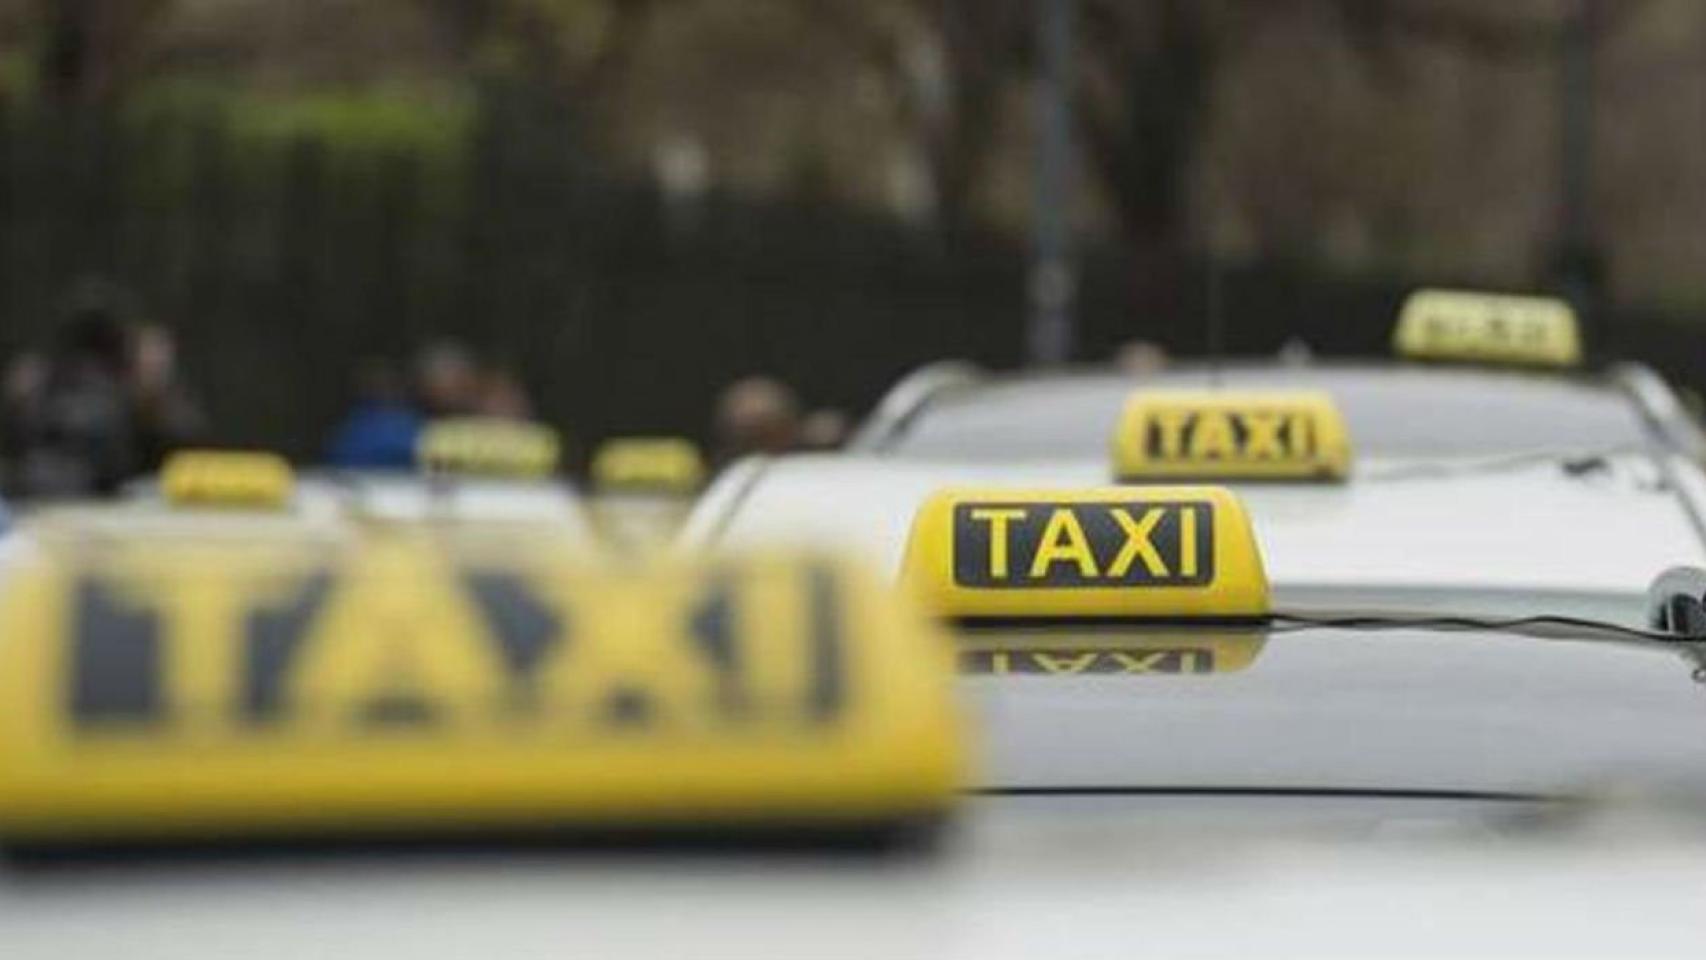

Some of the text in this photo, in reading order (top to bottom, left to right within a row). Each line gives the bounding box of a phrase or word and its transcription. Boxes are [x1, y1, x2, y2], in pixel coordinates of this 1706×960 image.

[1154, 411, 1309, 459] TAXI
[970, 507, 1198, 577] TAXI
[98, 572, 812, 726] TAXI
